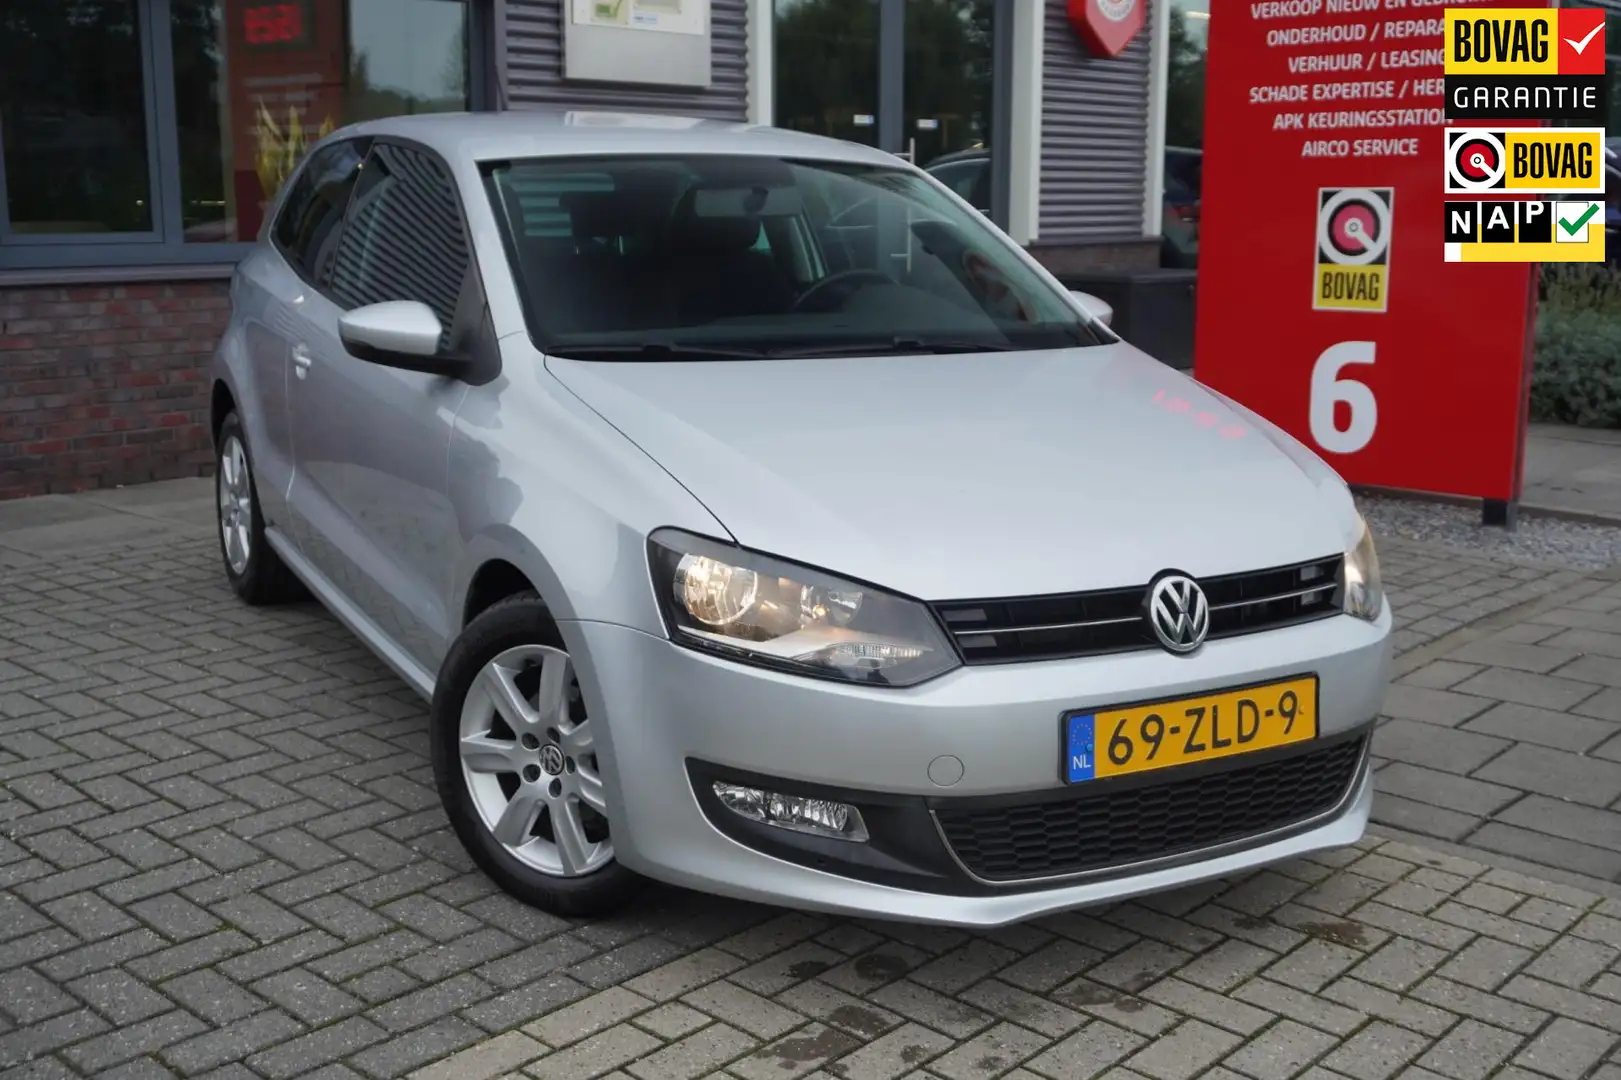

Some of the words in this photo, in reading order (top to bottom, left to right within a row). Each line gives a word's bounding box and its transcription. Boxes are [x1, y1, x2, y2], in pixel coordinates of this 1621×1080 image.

[1250, 0, 1322, 19] VERKOOP
[1266, 24, 1366, 47] ONDERHOUD
[1288, 53, 1363, 73] VERHUUR
[1249, 84, 1308, 104] SCHADE
[1312, 80, 1395, 100] EXPERTISE
[1272, 112, 1304, 131] APK
[1301, 140, 1349, 158] AIRCO
[1352, 138, 1419, 156] SERVICE
[1322, 272, 1380, 301] BOVAG
[1309, 340, 1378, 454] 6
[1107, 690, 1299, 766] 69-ZLD-9
[1072, 755, 1092, 770] NL
